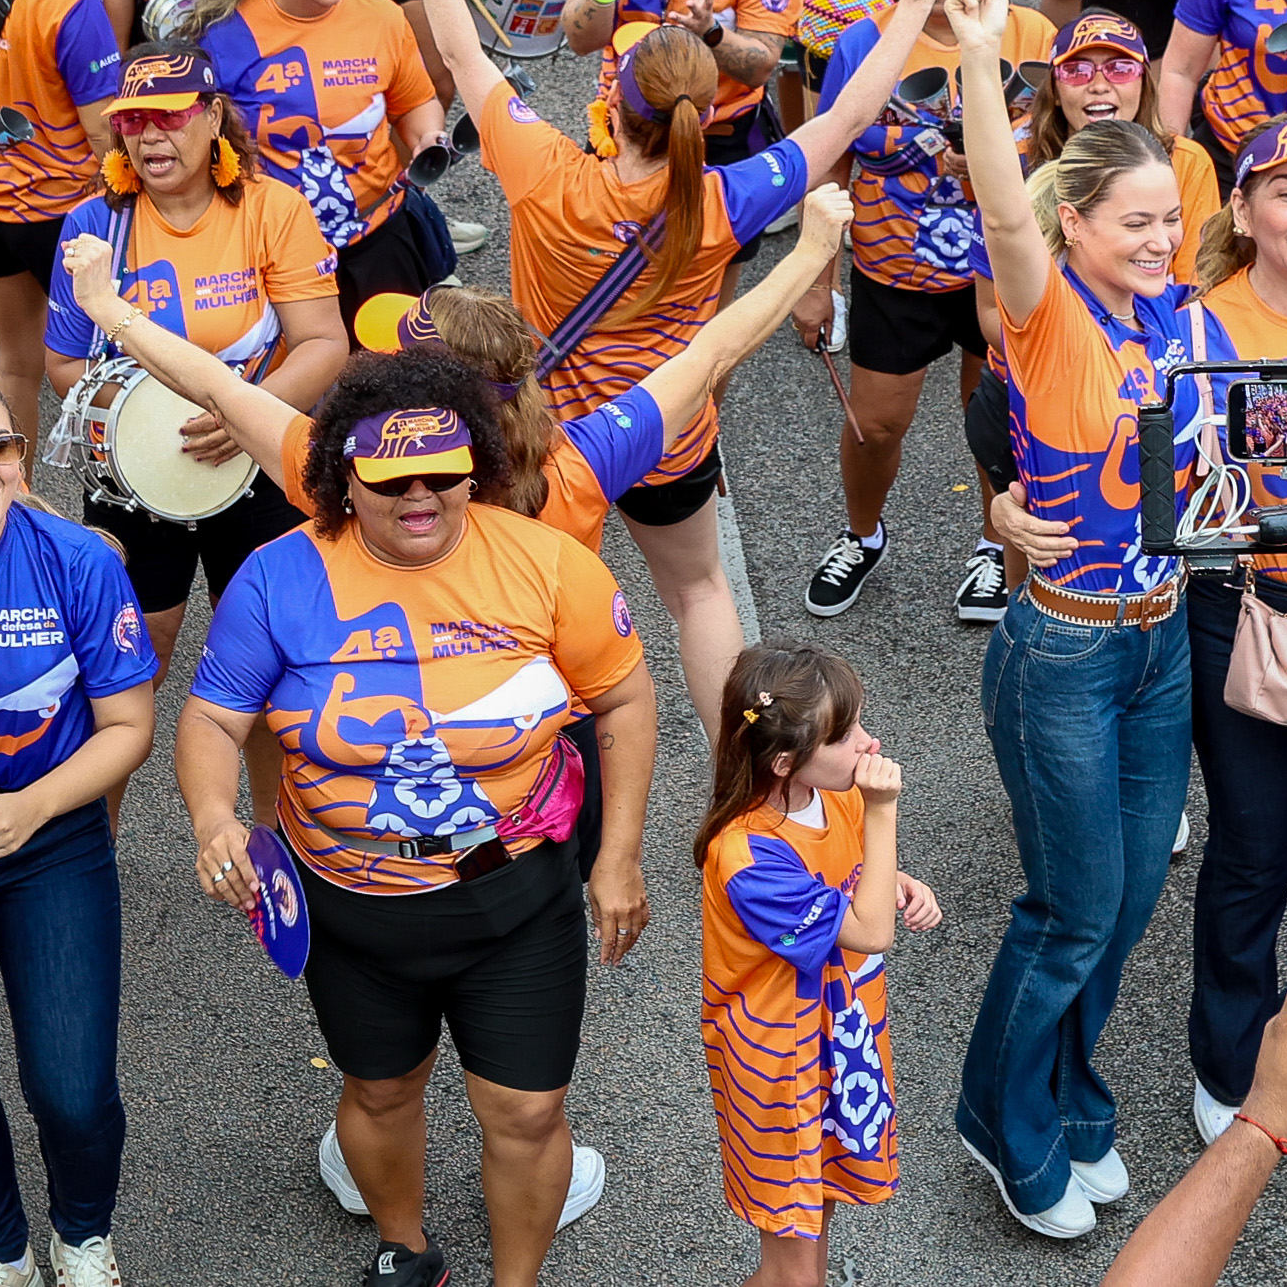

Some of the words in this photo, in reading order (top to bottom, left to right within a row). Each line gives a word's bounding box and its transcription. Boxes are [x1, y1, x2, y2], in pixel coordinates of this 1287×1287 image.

[100, 51, 121, 68] ALECE
[322, 57, 378, 70] MARCHA
[322, 75, 379, 88] MULHER
[194, 267, 257, 288] MARCHA
[211, 282, 247, 294] defesa
[194, 287, 259, 311] MULHER
[1, 620, 42, 631] defesa
[43, 620, 55, 629] da
[433, 634, 453, 643] em
[793, 904, 823, 938] ALECE
